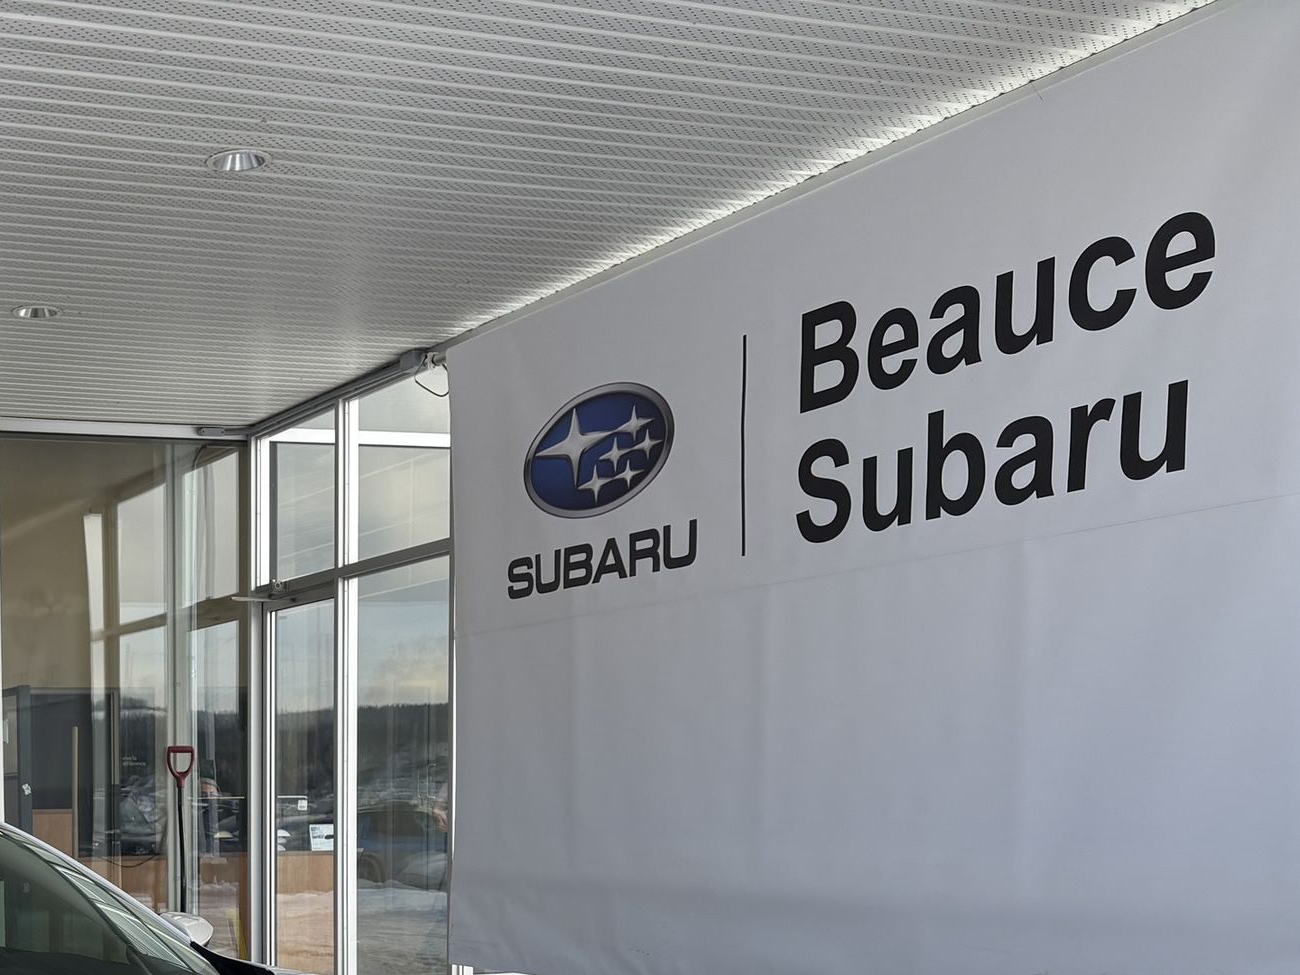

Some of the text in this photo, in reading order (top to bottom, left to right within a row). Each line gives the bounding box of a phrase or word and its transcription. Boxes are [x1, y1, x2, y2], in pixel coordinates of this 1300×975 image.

[799, 211, 1216, 414] Beauce
[795, 379, 1189, 543] Subaru
[506, 518, 698, 600] SUBARU
